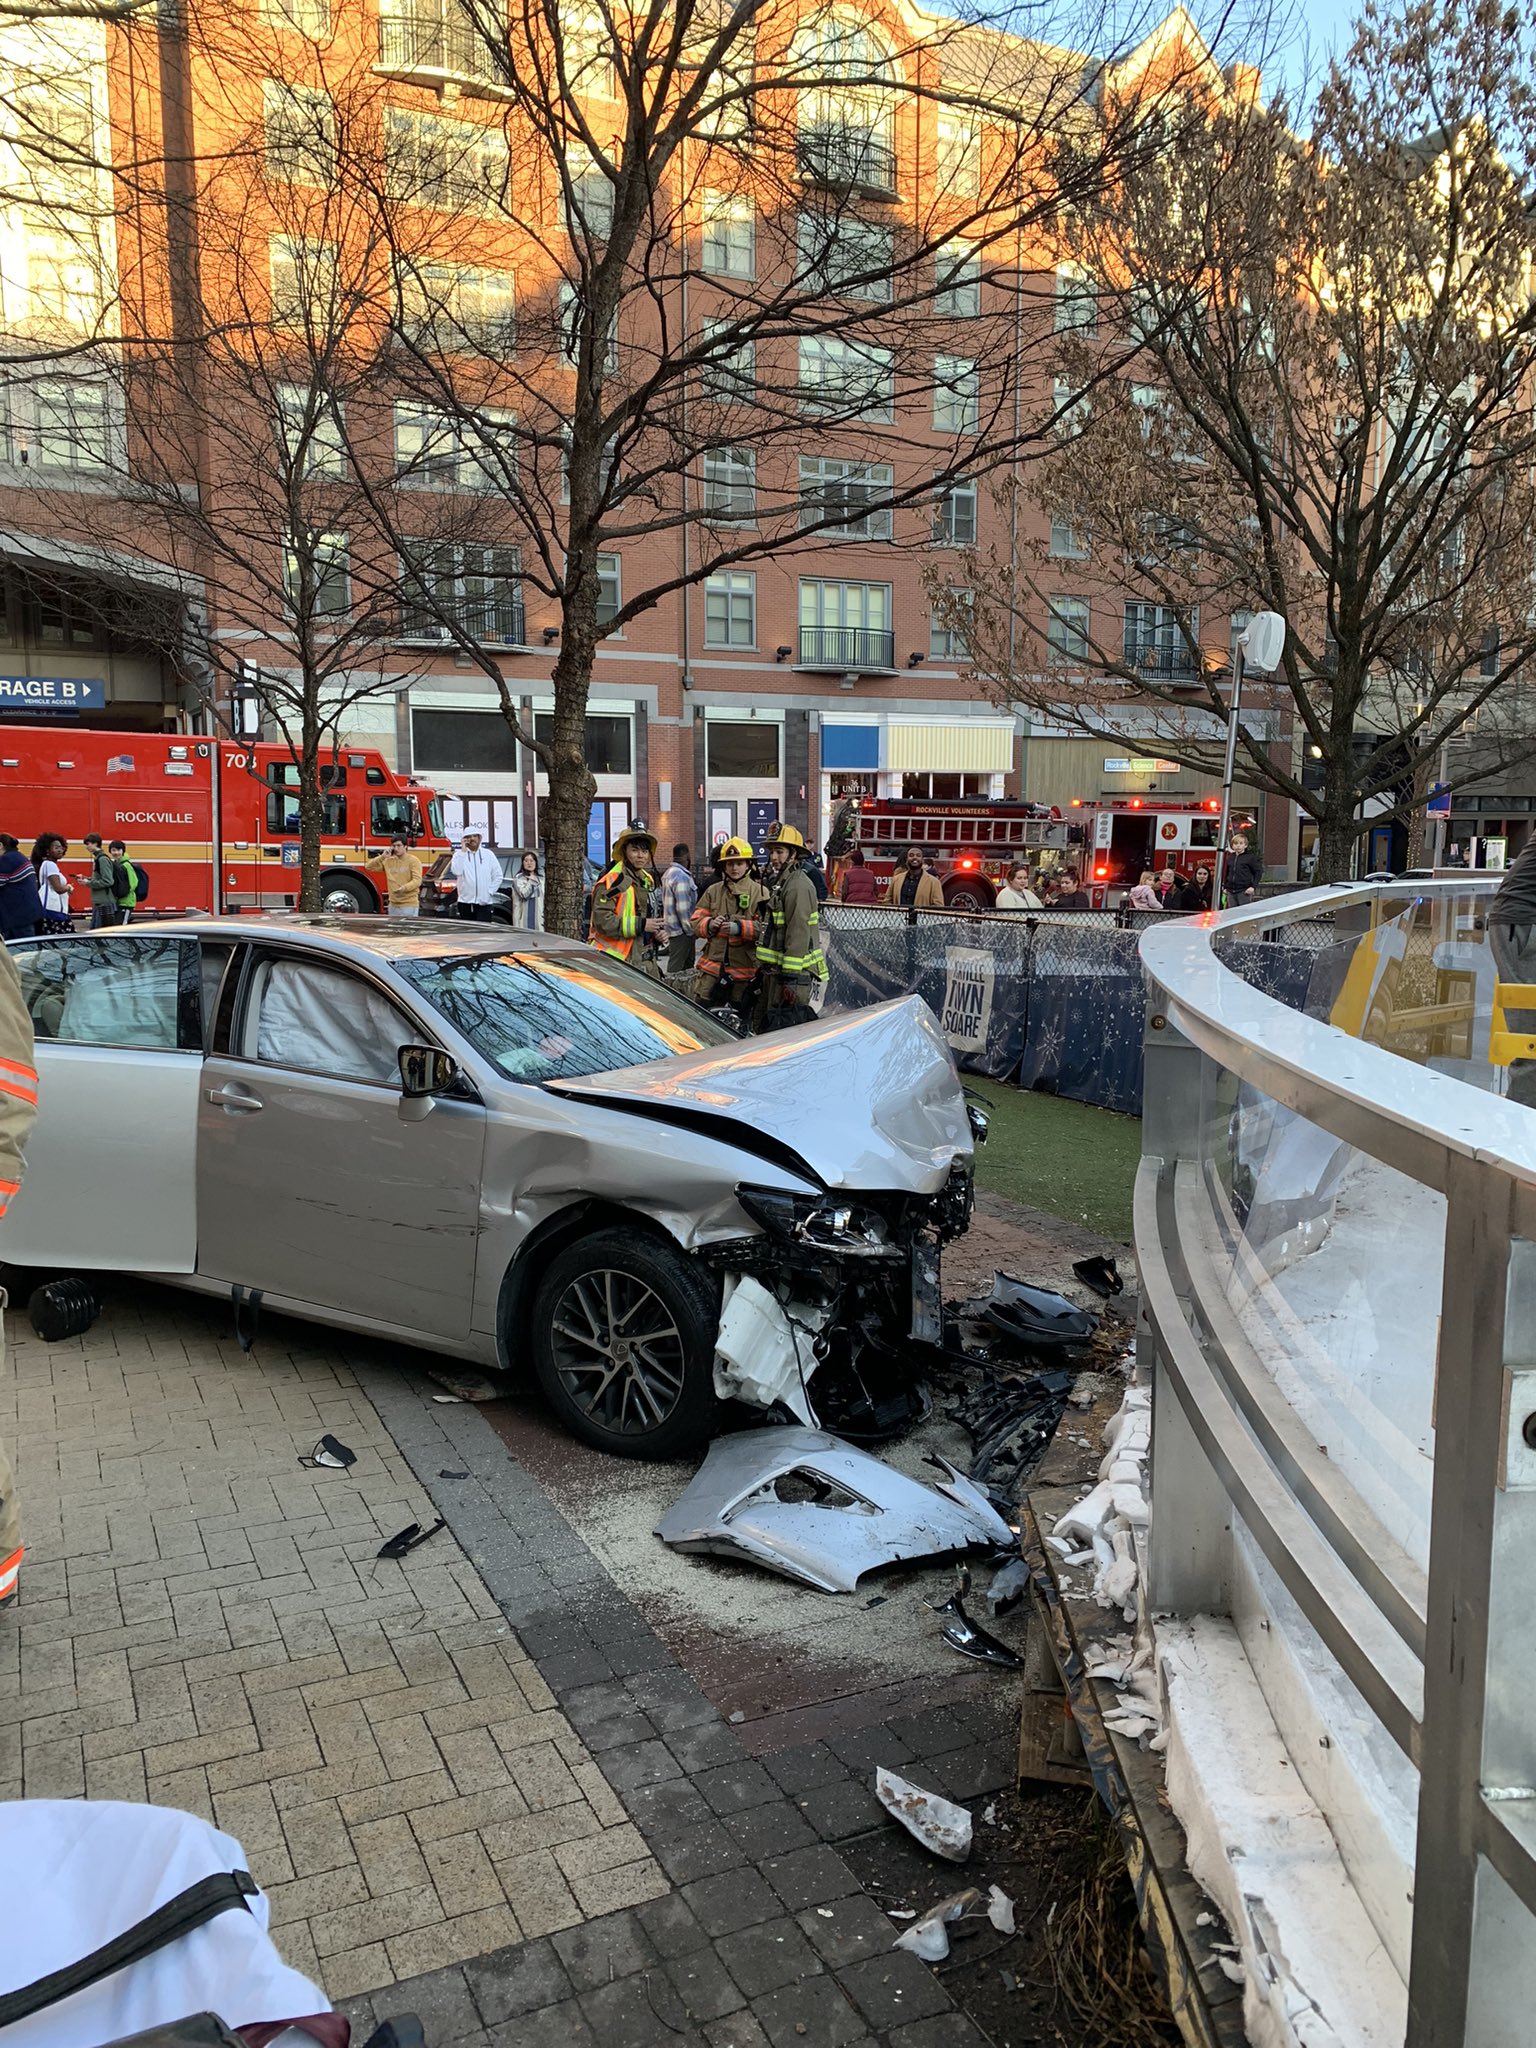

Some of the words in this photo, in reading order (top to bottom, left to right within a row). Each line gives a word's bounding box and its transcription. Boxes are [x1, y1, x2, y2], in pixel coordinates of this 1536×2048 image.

[62, 682, 76, 698] B
[1133, 760, 1153, 769] Science
[1158, 760, 1177, 769] Center
[842, 785, 861, 793] UNIT
[915, 806, 949, 814] ROCKVILLE
[951, 807, 990, 815] VOLUNTEERS
[115, 811, 193, 824] ROCKVILLE
